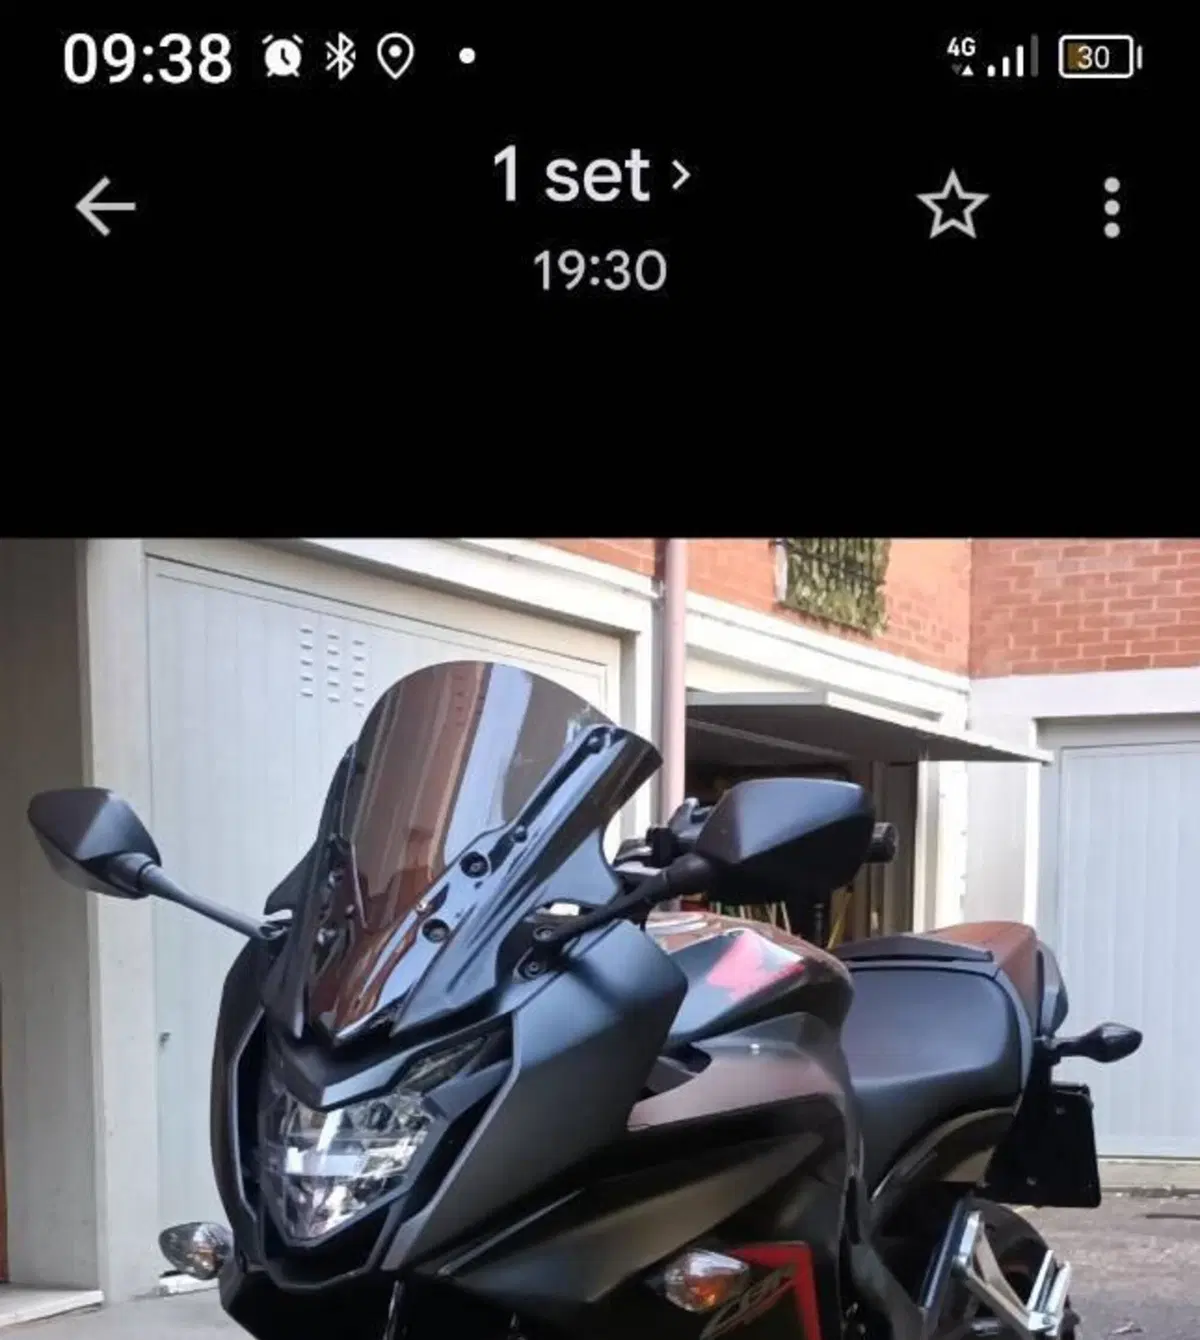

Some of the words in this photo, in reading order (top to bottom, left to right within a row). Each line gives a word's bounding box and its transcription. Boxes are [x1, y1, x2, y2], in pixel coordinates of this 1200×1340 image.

[63, 32, 232, 85] 09:38
[946, 36, 976, 57] 4G
[1077, 45, 1110, 70] 30
[493, 147, 518, 202] 1
[545, 148, 650, 203] set
[534, 249, 668, 291] 19:30
